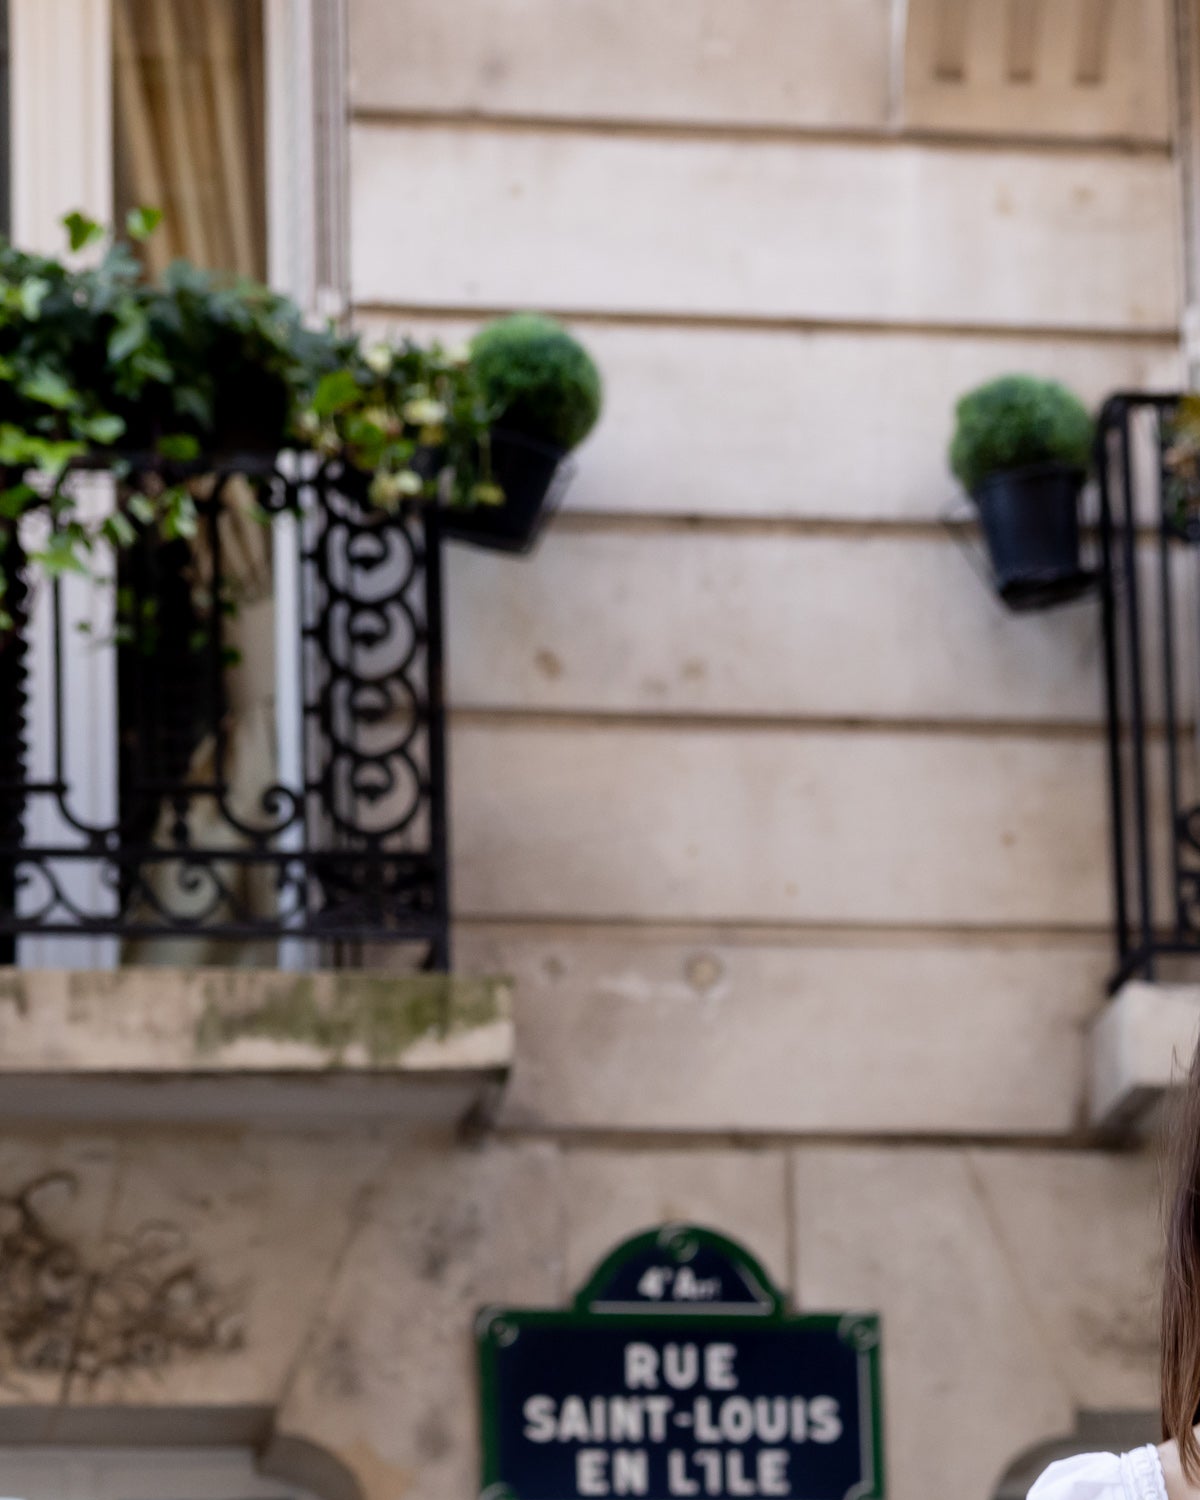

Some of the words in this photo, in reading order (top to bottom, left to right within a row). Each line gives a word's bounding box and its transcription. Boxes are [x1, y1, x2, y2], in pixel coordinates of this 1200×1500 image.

[624, 1342, 738, 1390] RUE
[523, 1395, 842, 1443] SAINT-LOUIS
[575, 1449, 649, 1496] EN
